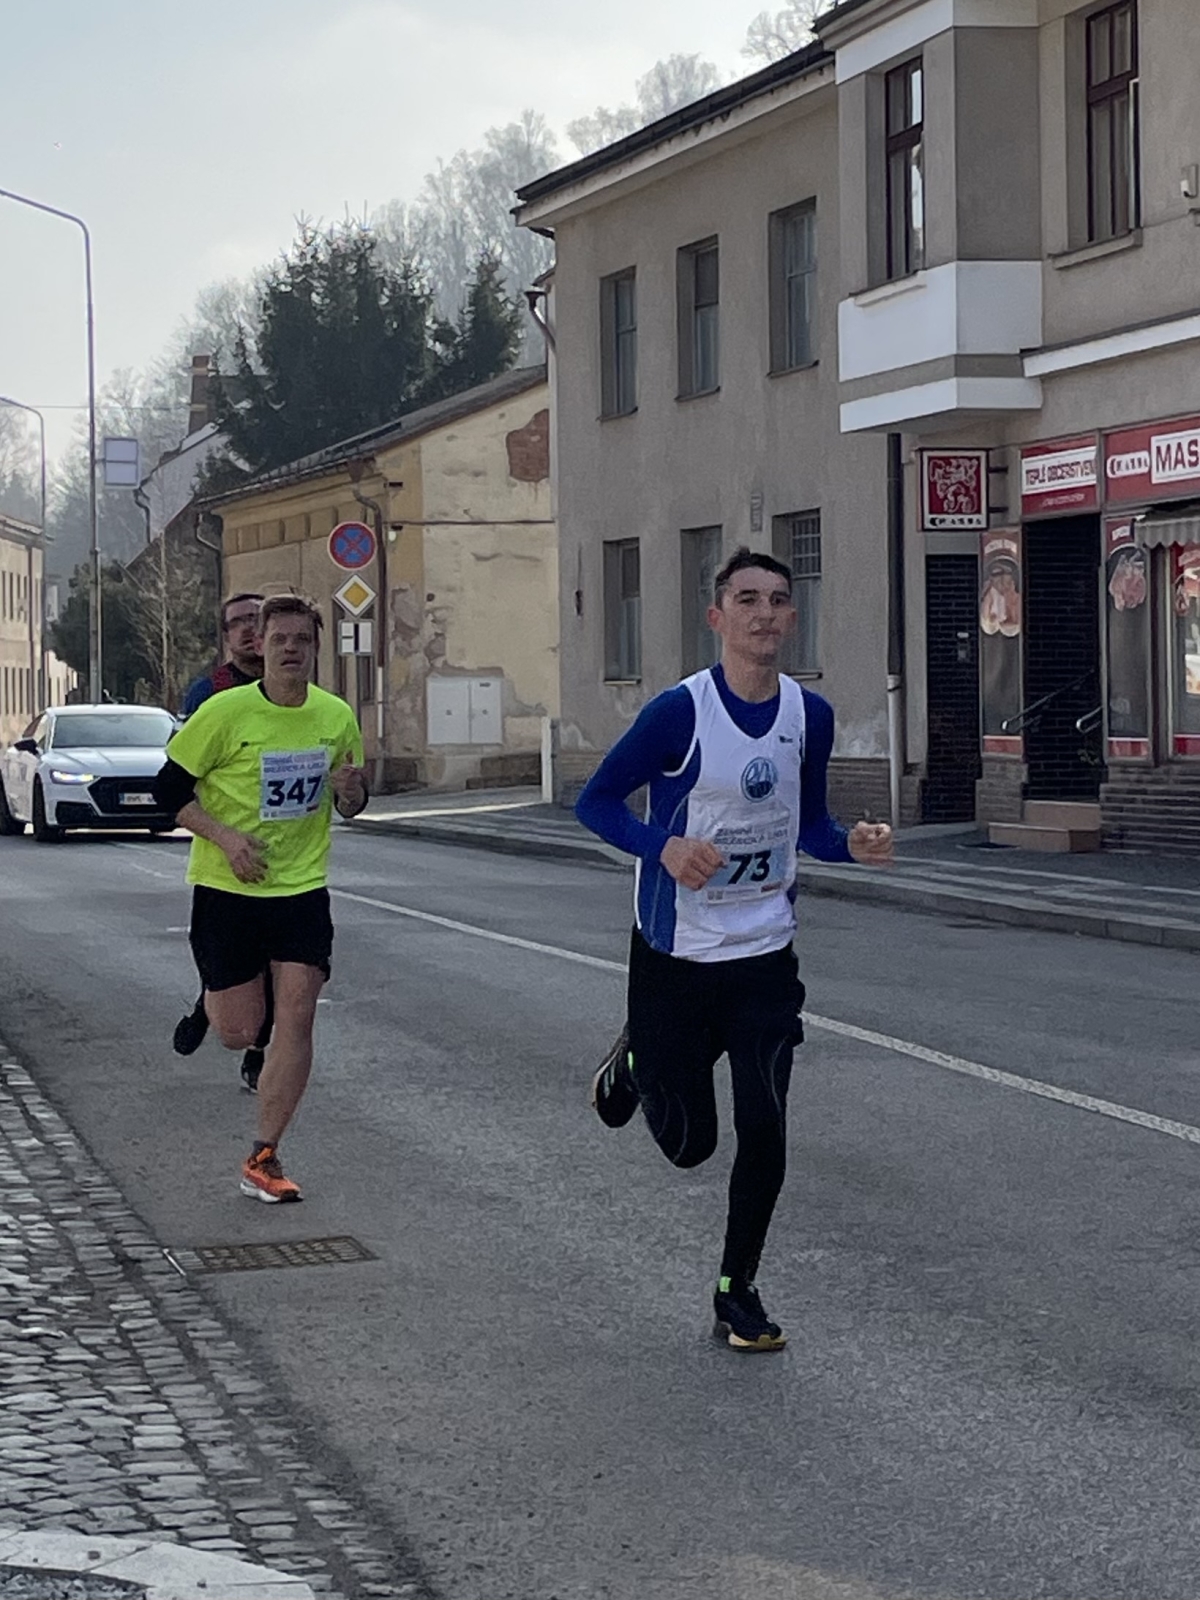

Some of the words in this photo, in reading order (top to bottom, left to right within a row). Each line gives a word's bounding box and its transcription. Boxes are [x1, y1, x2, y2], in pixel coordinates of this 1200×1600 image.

[1156, 438, 1199, 473] MAS
[266, 775, 322, 807] 347
[728, 851, 771, 885] 73
